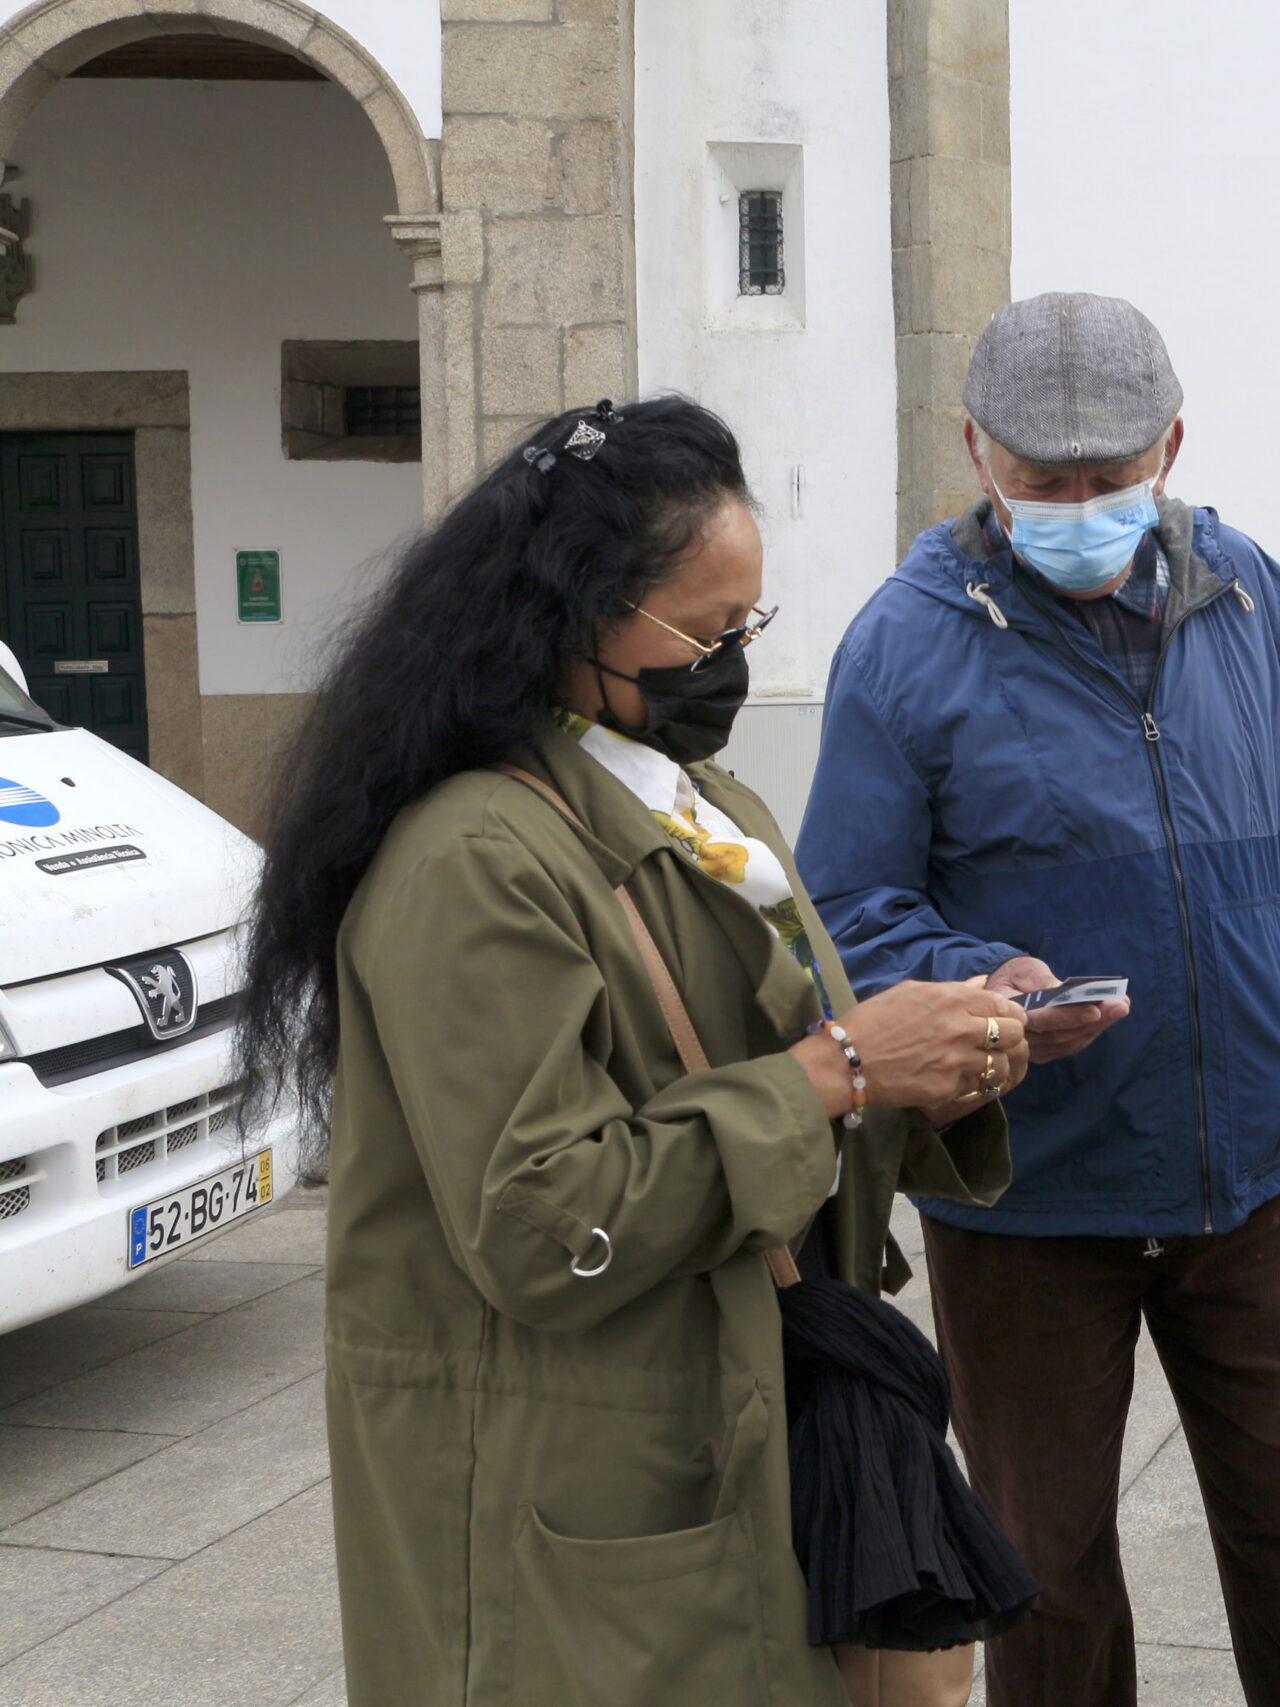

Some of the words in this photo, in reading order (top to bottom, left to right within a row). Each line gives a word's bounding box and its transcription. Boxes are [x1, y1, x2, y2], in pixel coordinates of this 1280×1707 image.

[60, 824, 144, 845] MINOLTA
[42, 861, 71, 872] Venda
[112, 848, 141, 858] Técnica
[260, 1158, 271, 1174] 06
[260, 1183, 272, 1199] 02
[135, 1242, 143, 1256] P
